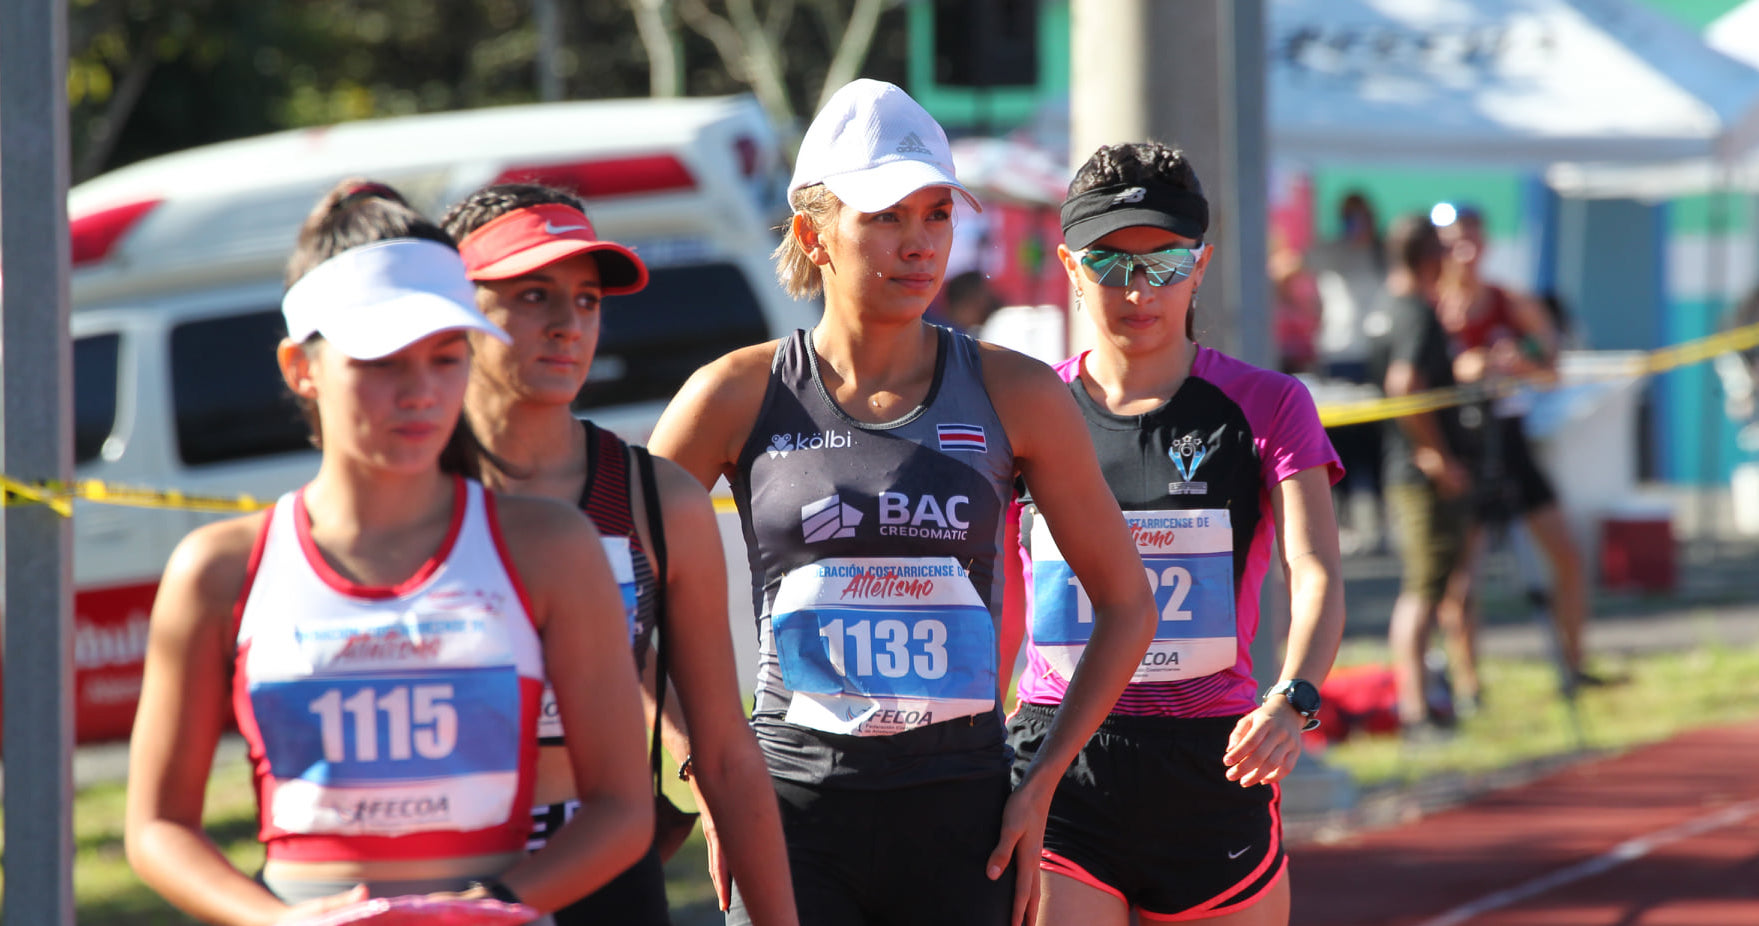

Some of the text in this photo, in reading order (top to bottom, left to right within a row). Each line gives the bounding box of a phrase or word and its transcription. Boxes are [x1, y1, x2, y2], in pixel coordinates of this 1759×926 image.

[796, 430, 851, 451] kölbi
[879, 491, 970, 530] BAC
[1197, 517, 1210, 528] DE
[879, 525, 969, 541] CREDOMATIC
[1130, 523, 1175, 549] tismo
[868, 565, 954, 579] COSTARRICENSE
[819, 618, 948, 680] 1133
[1141, 651, 1179, 666] COA
[309, 684, 458, 763] 1115
[868, 709, 933, 726] FECOA
